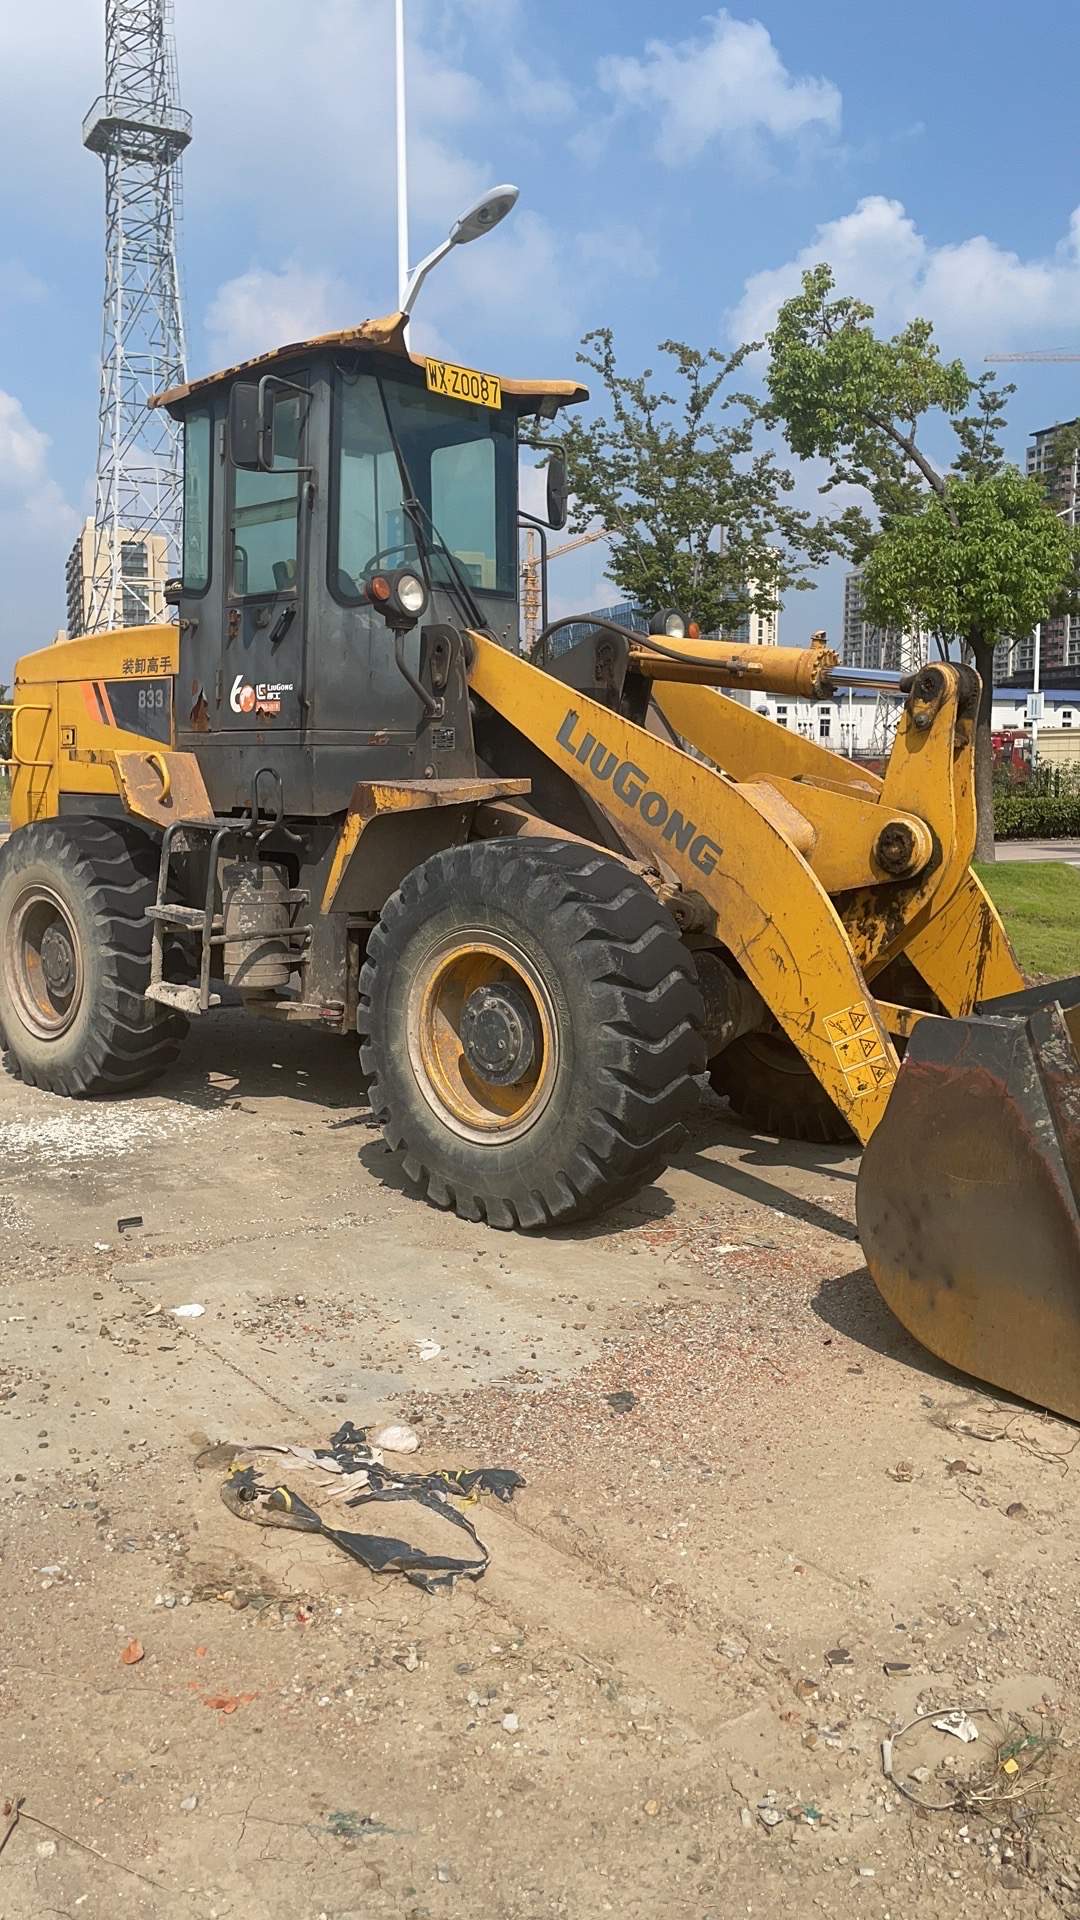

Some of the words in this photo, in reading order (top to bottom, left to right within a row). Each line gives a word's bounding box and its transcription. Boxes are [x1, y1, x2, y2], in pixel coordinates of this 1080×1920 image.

[122, 656, 172, 675] 装卸高手
[138, 689, 164, 708] 833
